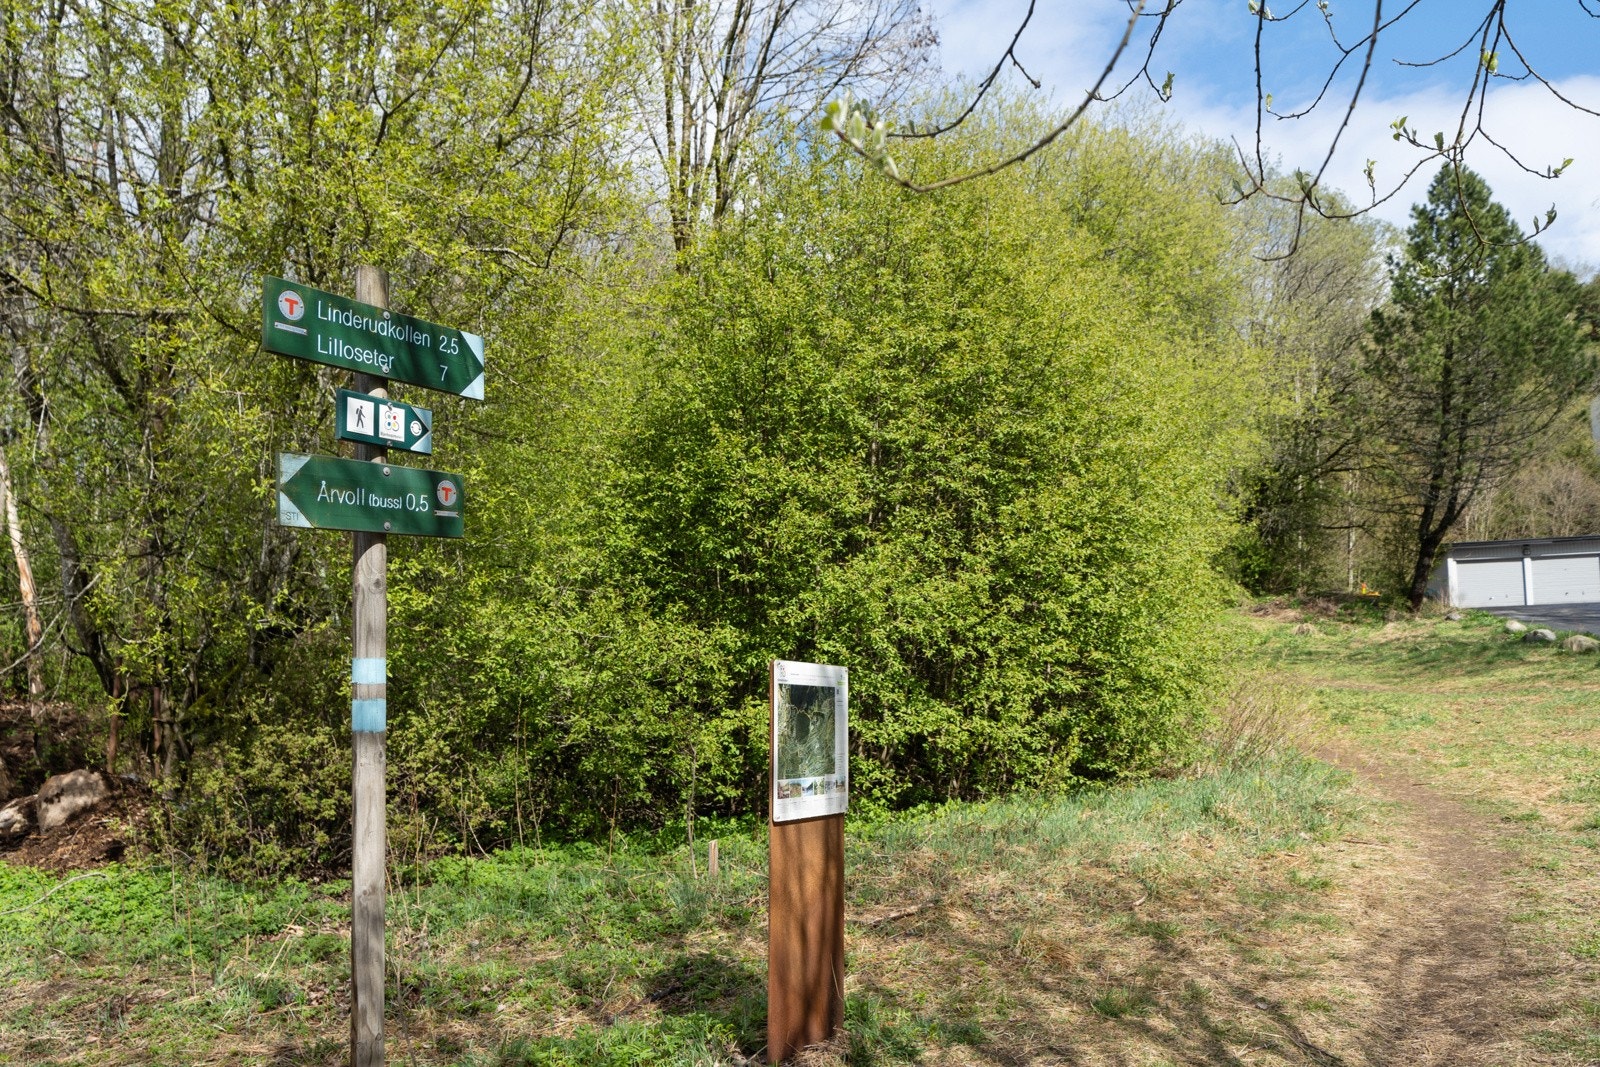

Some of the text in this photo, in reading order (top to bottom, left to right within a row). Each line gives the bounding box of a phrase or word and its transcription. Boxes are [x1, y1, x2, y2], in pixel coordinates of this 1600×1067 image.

[284, 297, 299, 316] T
[317, 300, 459, 355] Linderudkollen 2,5
[317, 334, 449, 382] Lilloseter 7
[317, 480, 429, 512] Årvoll (buss) 0,5
[441, 486, 453, 502] T
